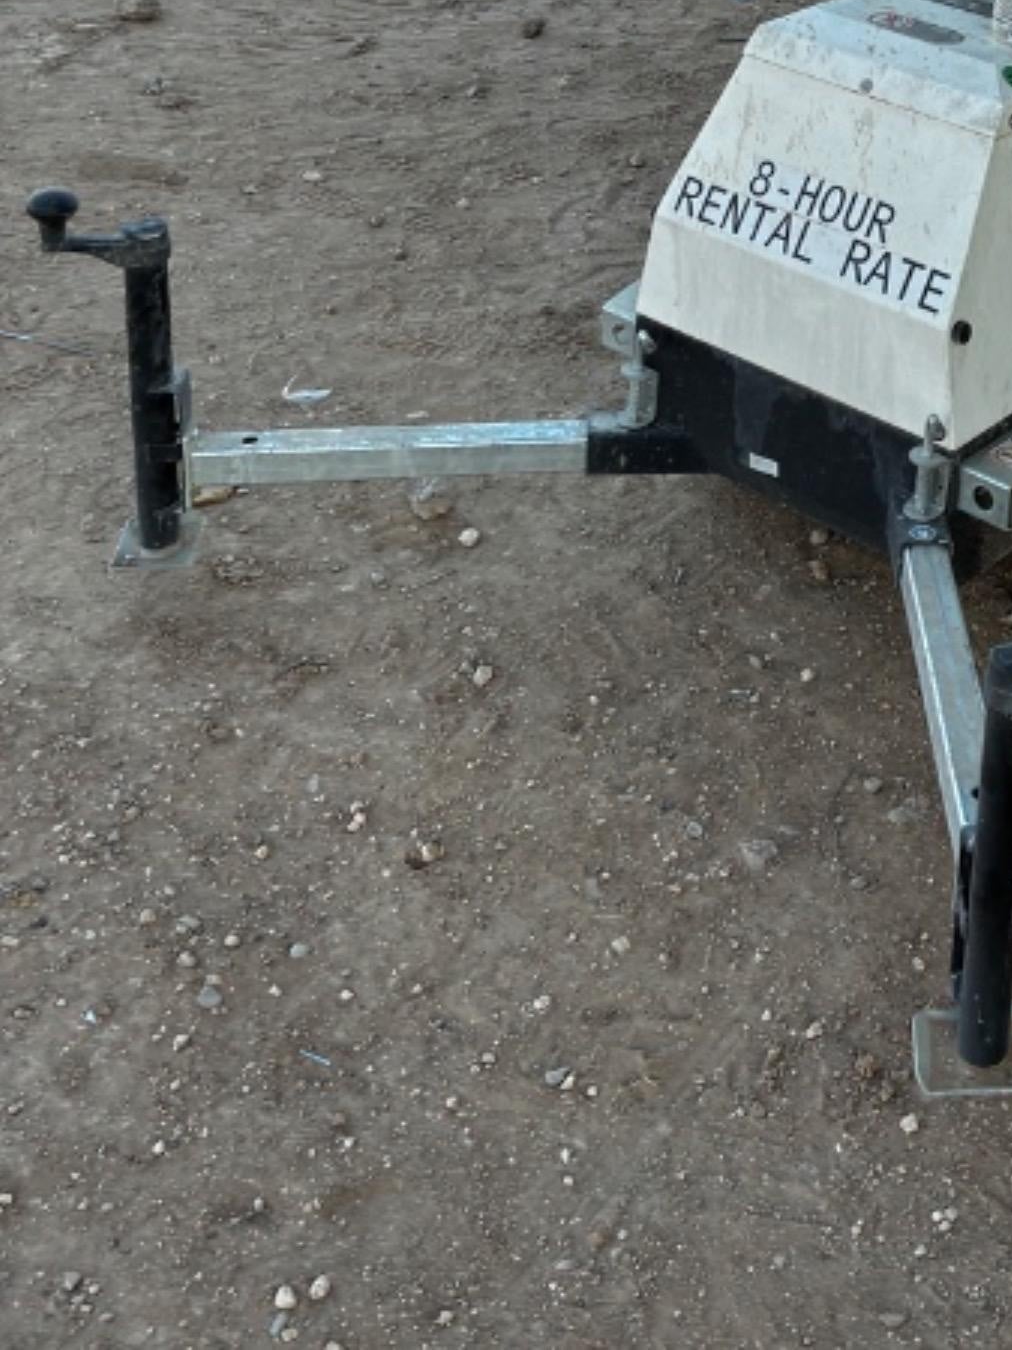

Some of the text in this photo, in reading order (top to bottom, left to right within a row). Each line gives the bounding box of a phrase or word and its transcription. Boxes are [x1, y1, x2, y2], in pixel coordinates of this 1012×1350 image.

[674, 176, 951, 314] RENTAL RATE
[750, 161, 895, 244] 8-HOUR
